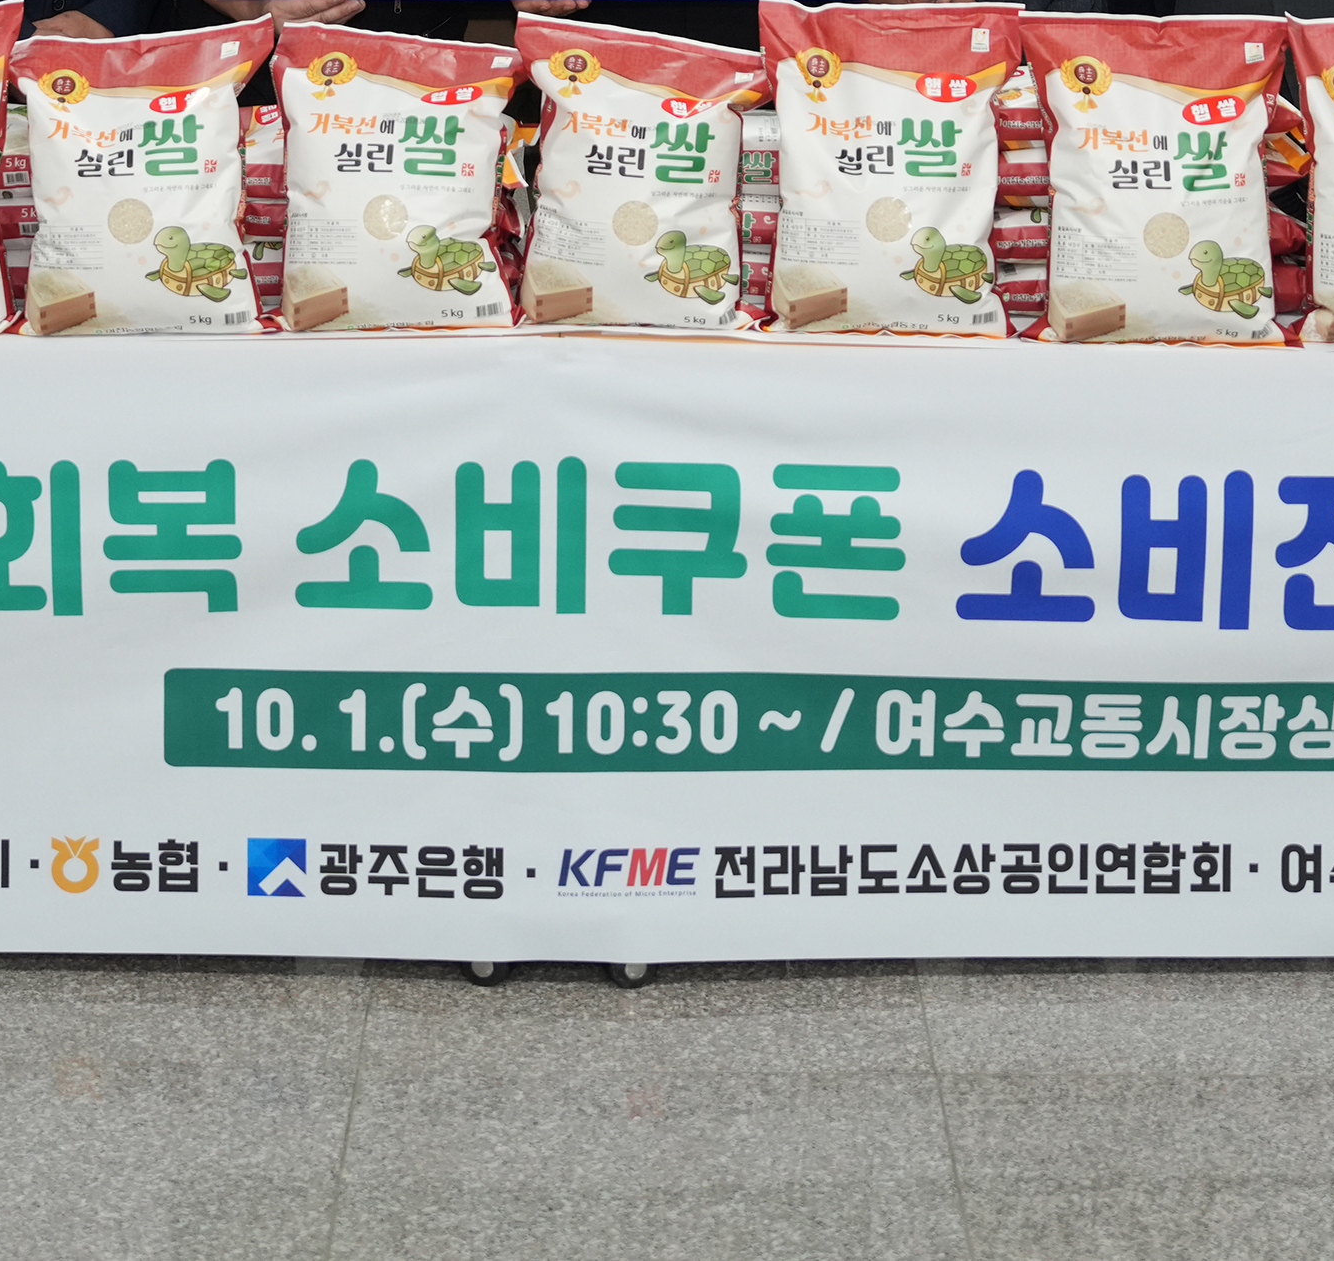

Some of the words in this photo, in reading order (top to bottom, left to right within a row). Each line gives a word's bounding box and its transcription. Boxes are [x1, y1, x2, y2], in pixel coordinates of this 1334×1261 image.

[137, 114, 204, 176] 쌀
[335, 143, 394, 173] 실린
[398, 115, 465, 177] 쌀
[649, 121, 715, 184] 쌀
[897, 117, 962, 177] 쌀
[5, 157, 12, 168] 5
[14, 156, 27, 170] kg
[75, 149, 134, 177] 실린
[585, 144, 646, 179] 실린
[743, 151, 777, 183] 쌀
[835, 145, 894, 176] 실린
[1108, 159, 1172, 189] 실린
[1173, 131, 1231, 192] 쌀
[21, 208, 28, 218] 5
[189, 316, 196, 324] 5
[199, 315, 212, 326] kg
[441, 309, 448, 318] 5
[451, 309, 464, 319] kg
[684, 316, 691, 324] 5
[693, 316, 706, 325] kg
[937, 314, 944, 322] 5
[947, 313, 960, 324] kg
[1216, 328, 1223, 336] 5
[1225, 328, 1239, 338] kg
[293, 456, 906, 620] 소비쿠폰
[545, 687, 739, 754] 10:30
[110, 839, 200, 893] 농협
[319, 842, 506, 900] 광주은행
[557, 847, 701, 887] KFME
[714, 840, 1232, 899] 전라남도소상공인연합회
[557, 890, 578, 898] Korea
[581, 890, 622, 898] Federation
[624, 890, 633, 898] of
[658, 889, 697, 898] Enterprise
